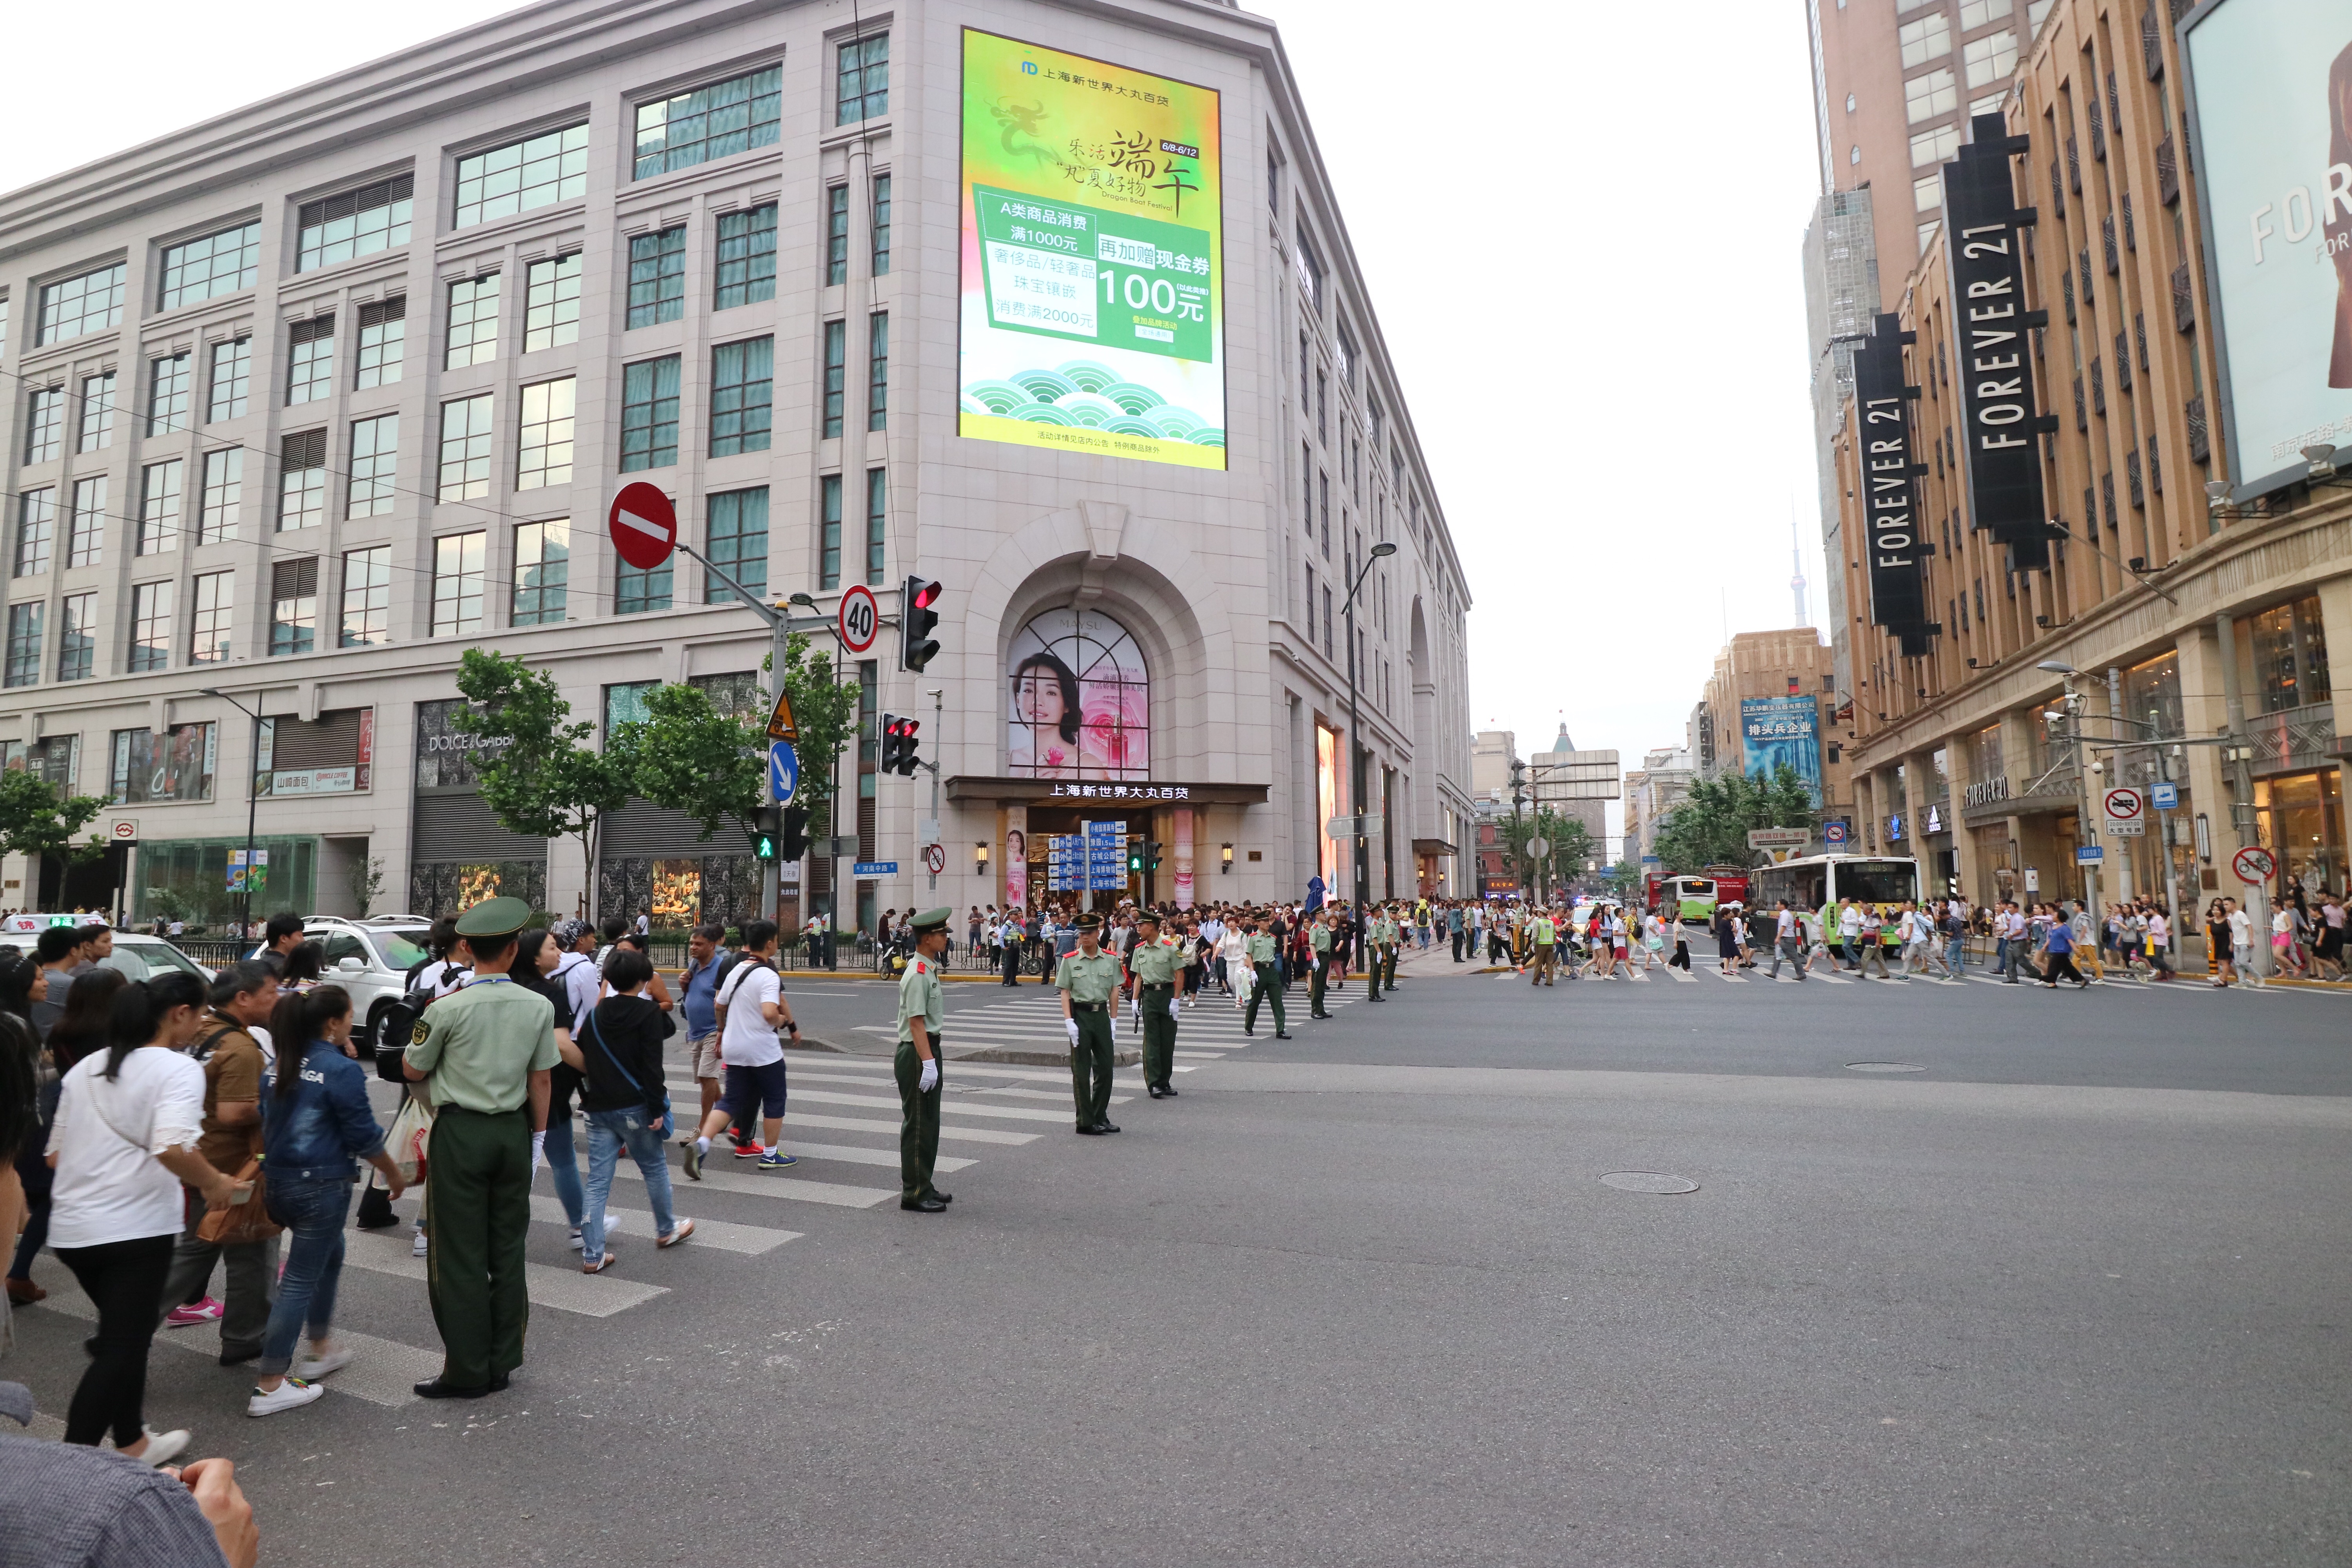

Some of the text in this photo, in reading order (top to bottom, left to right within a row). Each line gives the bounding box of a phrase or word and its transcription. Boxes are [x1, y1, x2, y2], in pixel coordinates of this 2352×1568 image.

[1043, 67, 1169, 107] 上海新世界大丸百货
[1069, 139, 1105, 160] 乐活
[1162, 142, 1196, 156] 6/8-6/12
[1102, 191, 1172, 212] Dragon Boat Festival
[1001, 202, 1087, 230] A类商品消费
[1011, 225, 1078, 251] 满1000元
[2315, 228, 2352, 264] FOR
[994, 248, 1095, 279] 奢侈品/轻奢品
[1100, 238, 1210, 276] 再加赠现金券
[1014, 276, 1076, 299] 珠宝镶嵌
[996, 298, 1094, 328] 消费满2000元
[1132, 315, 1177, 330] 叠加品牌活动
[1962, 223, 2027, 450] FOREVER 21
[1037, 430, 1160, 454] 活动详情见店内公告 特例商品除外
[1867, 398, 1912, 568] FOREVER 21
[848, 602, 871, 637] 40
[1060, 619, 1102, 630] MAYSU
[1743, 702, 1815, 712] 江苏华鹏变压器有限公司
[1748, 722, 1812, 735] 排头兵企业
[278, 776, 309, 788] 山崎面包
[1050, 784, 1189, 799] 上海新世界大丸百货
[1966, 779, 1996, 808] FOREVER
[1091, 824, 1115, 832] 小桃园清真寺
[1091, 866, 1115, 874] 上海博物馆
[1091, 878, 1116, 887] 上海书城
